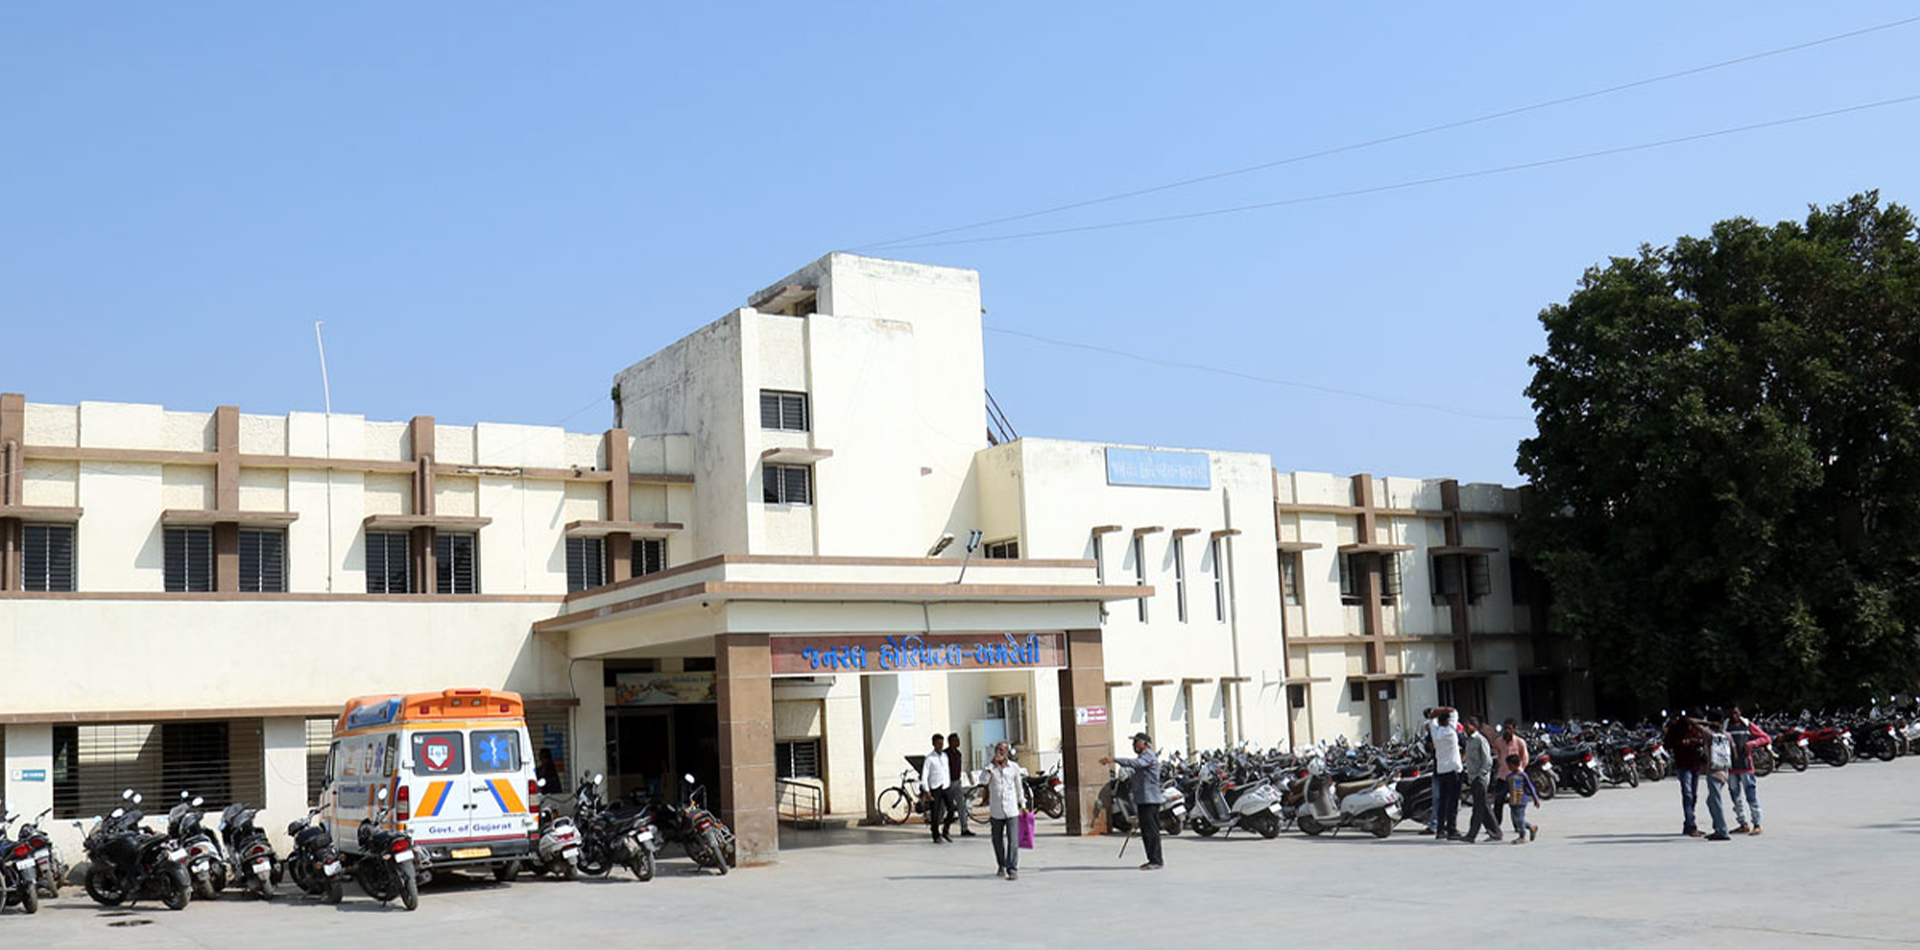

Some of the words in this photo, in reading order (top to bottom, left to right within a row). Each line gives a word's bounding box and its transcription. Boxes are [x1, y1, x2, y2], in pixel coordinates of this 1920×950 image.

[802, 645, 867, 669] જનરલ
[428, 826, 455, 834] Govt.
[472, 822, 512, 832] Gujarat
